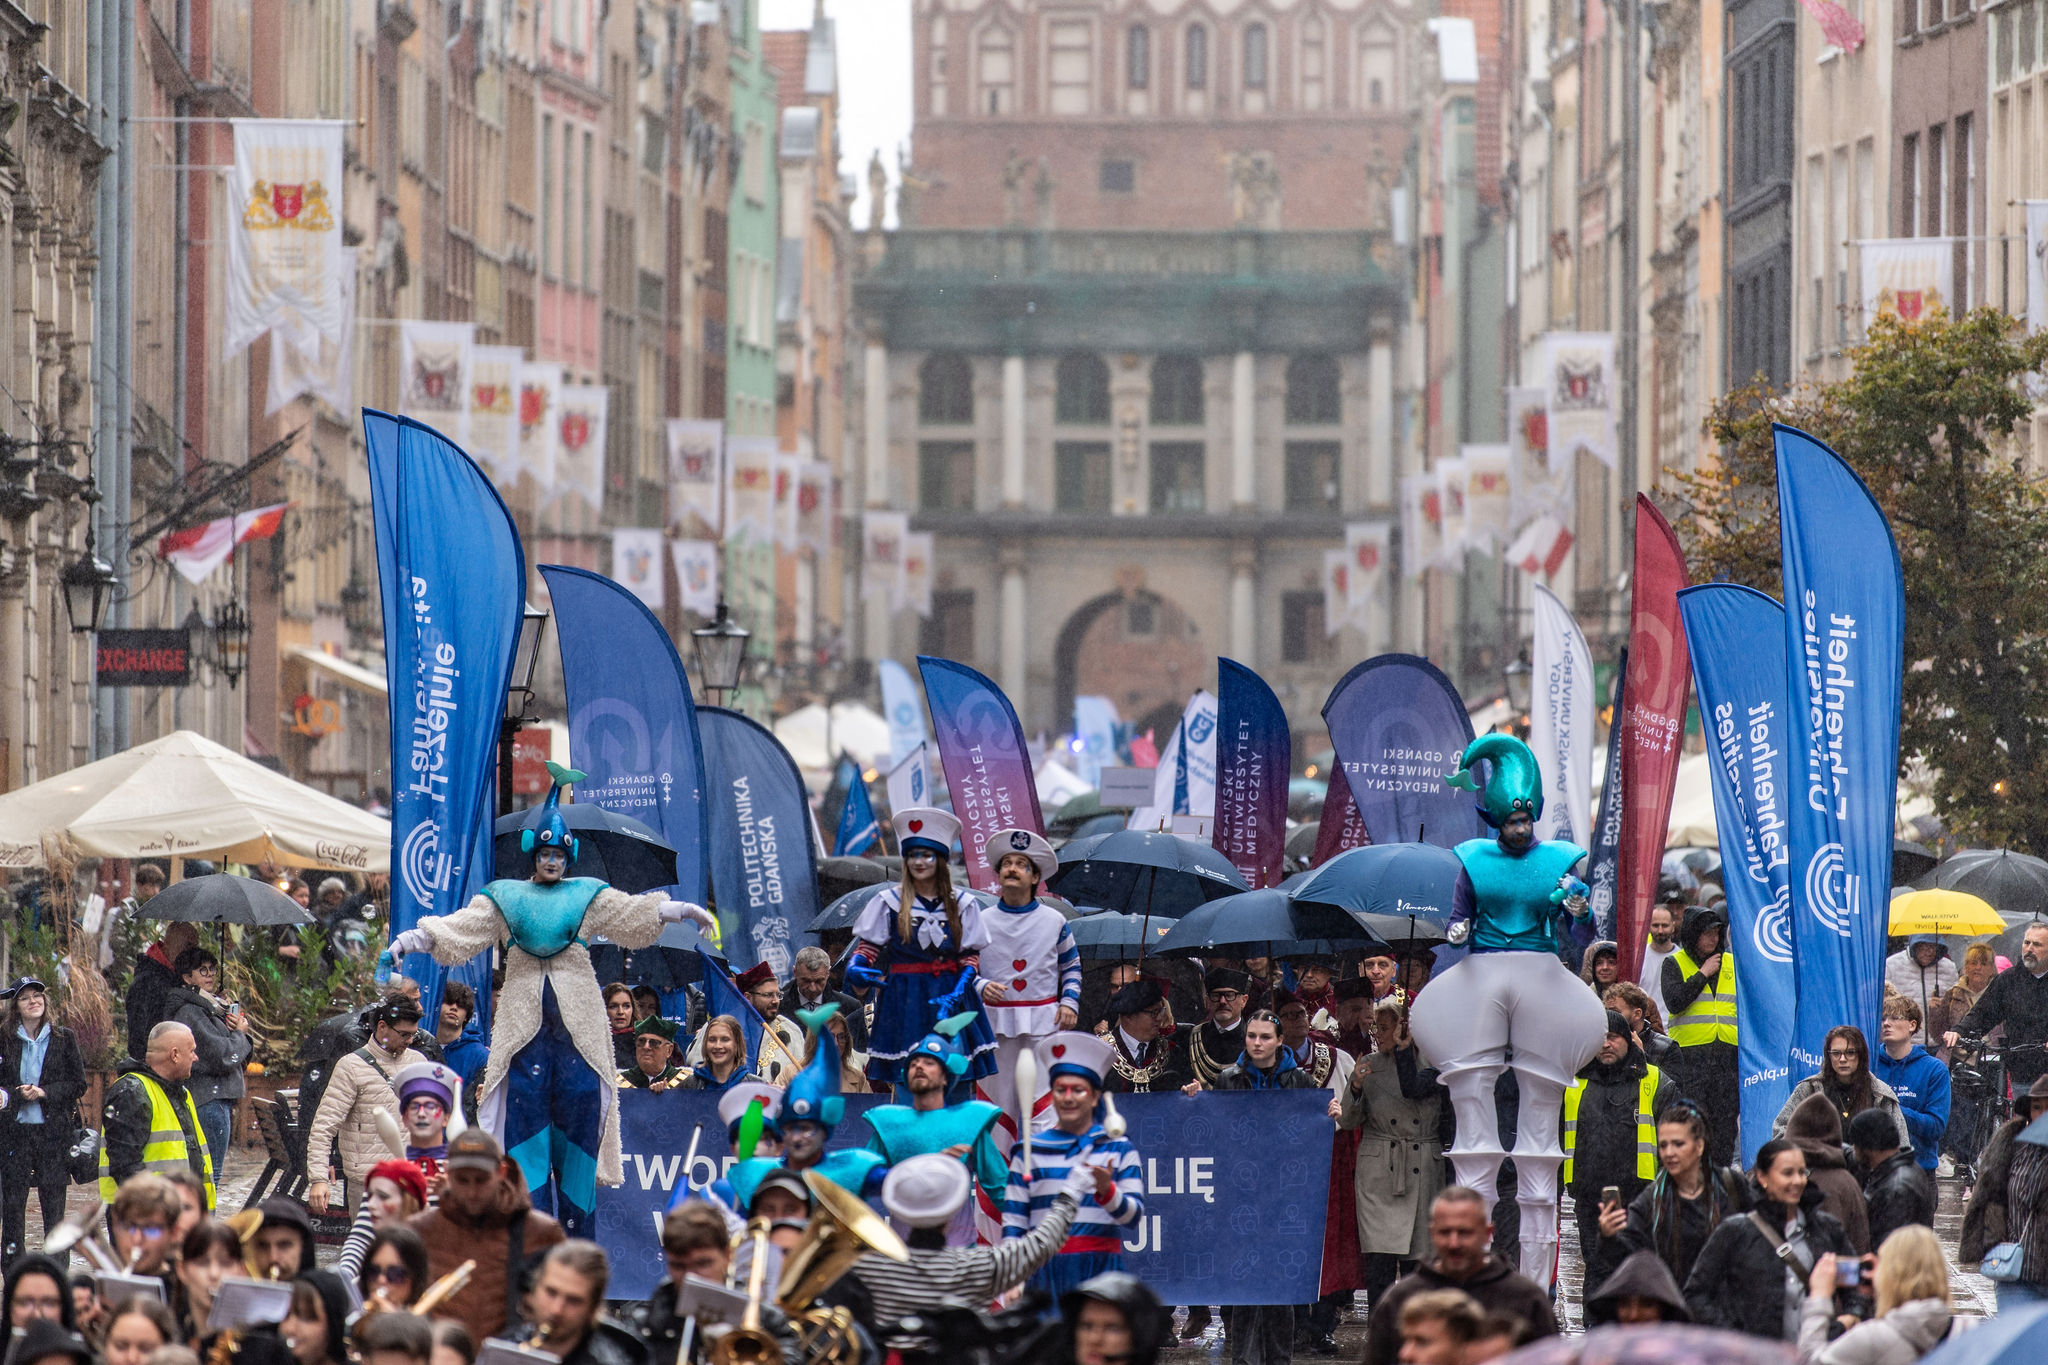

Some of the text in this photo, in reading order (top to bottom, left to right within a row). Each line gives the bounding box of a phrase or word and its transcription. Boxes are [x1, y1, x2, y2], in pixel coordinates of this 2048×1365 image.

[97, 648, 186, 673] EXCHANGE
[1231, 718, 1250, 854] UNIWERSYTET
[1246, 750, 1263, 855] MEDYCZNY
[732, 775, 766, 908] POLITECHNIKA
[758, 815, 784, 905] GDAŃSKA
[1147, 1156, 1215, 1203] LIĘ
